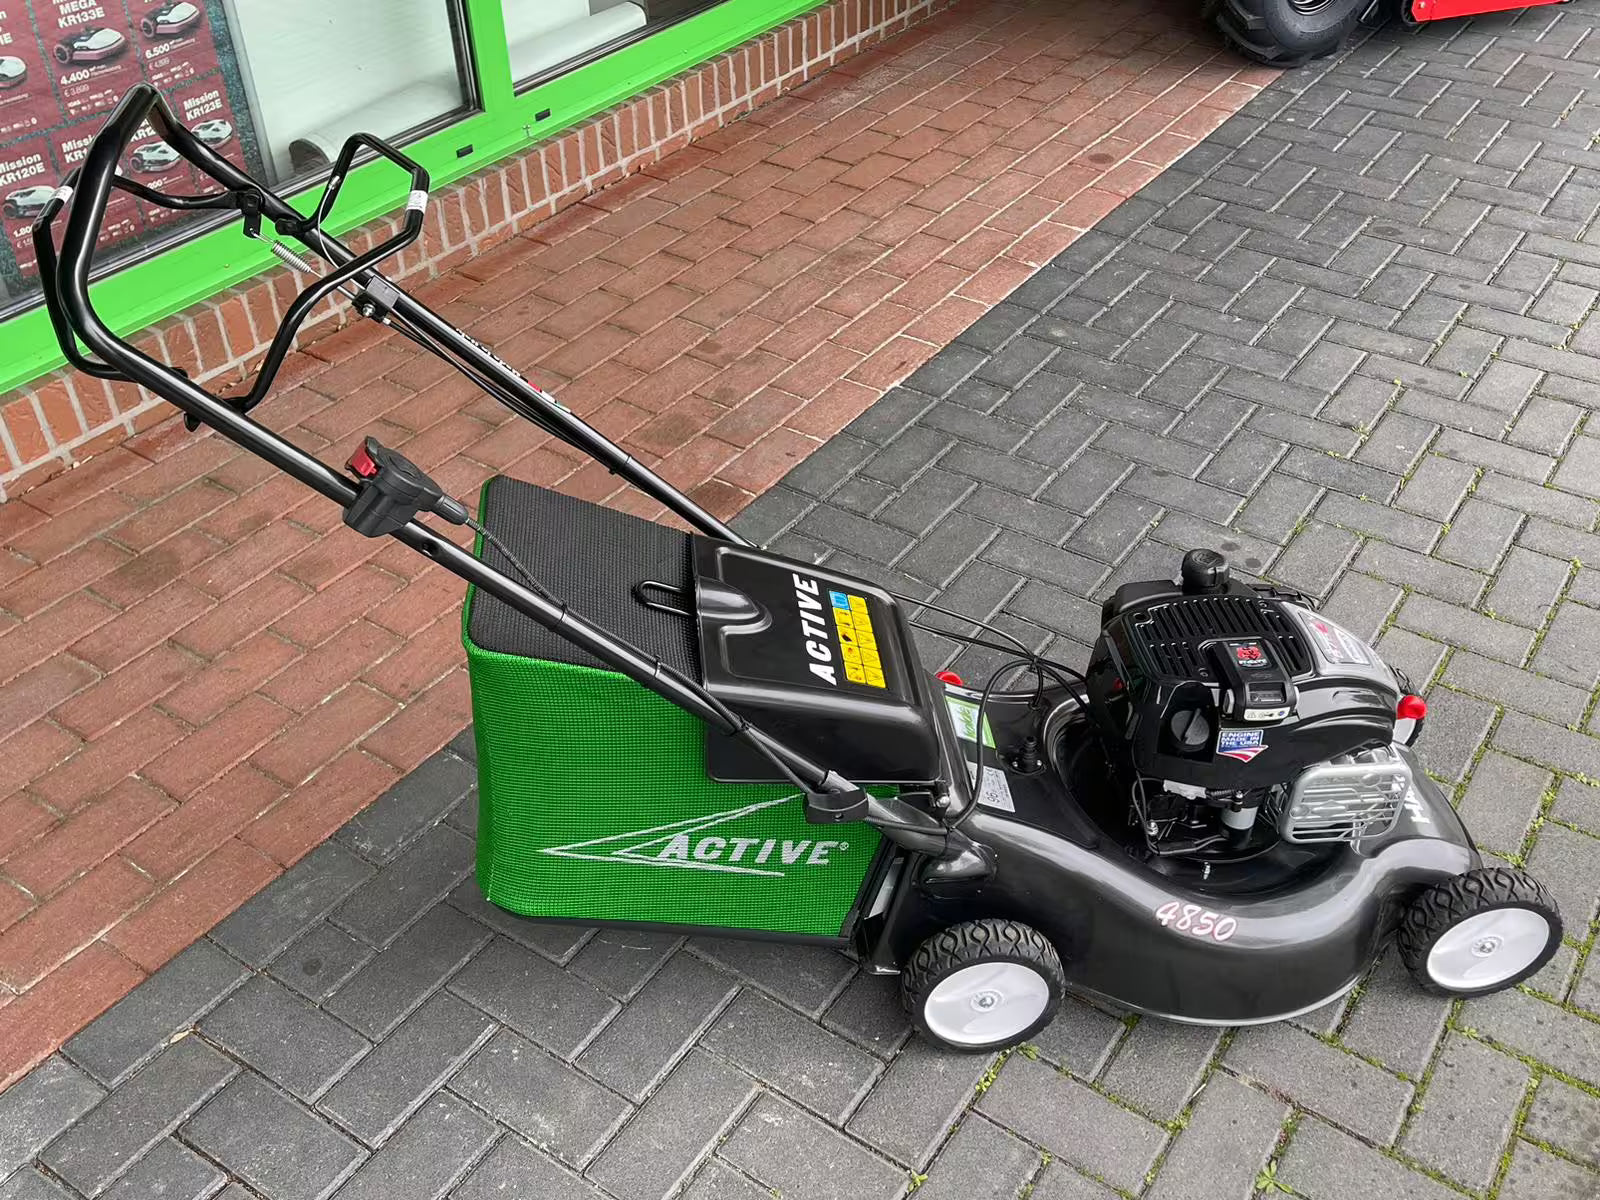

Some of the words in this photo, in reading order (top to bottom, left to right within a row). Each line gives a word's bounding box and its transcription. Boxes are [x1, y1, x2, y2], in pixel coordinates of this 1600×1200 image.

[57, 6, 105, 29] KR133E
[60, 69, 90, 85] 4.400
[183, 90, 219, 110] Mission
[186, 98, 223, 121] KR123E
[61, 134, 95, 153] Missi
[65, 147, 88, 164] KR1
[792, 573, 837, 686] ACTIVE
[1155, 900, 1238, 942] 4850
